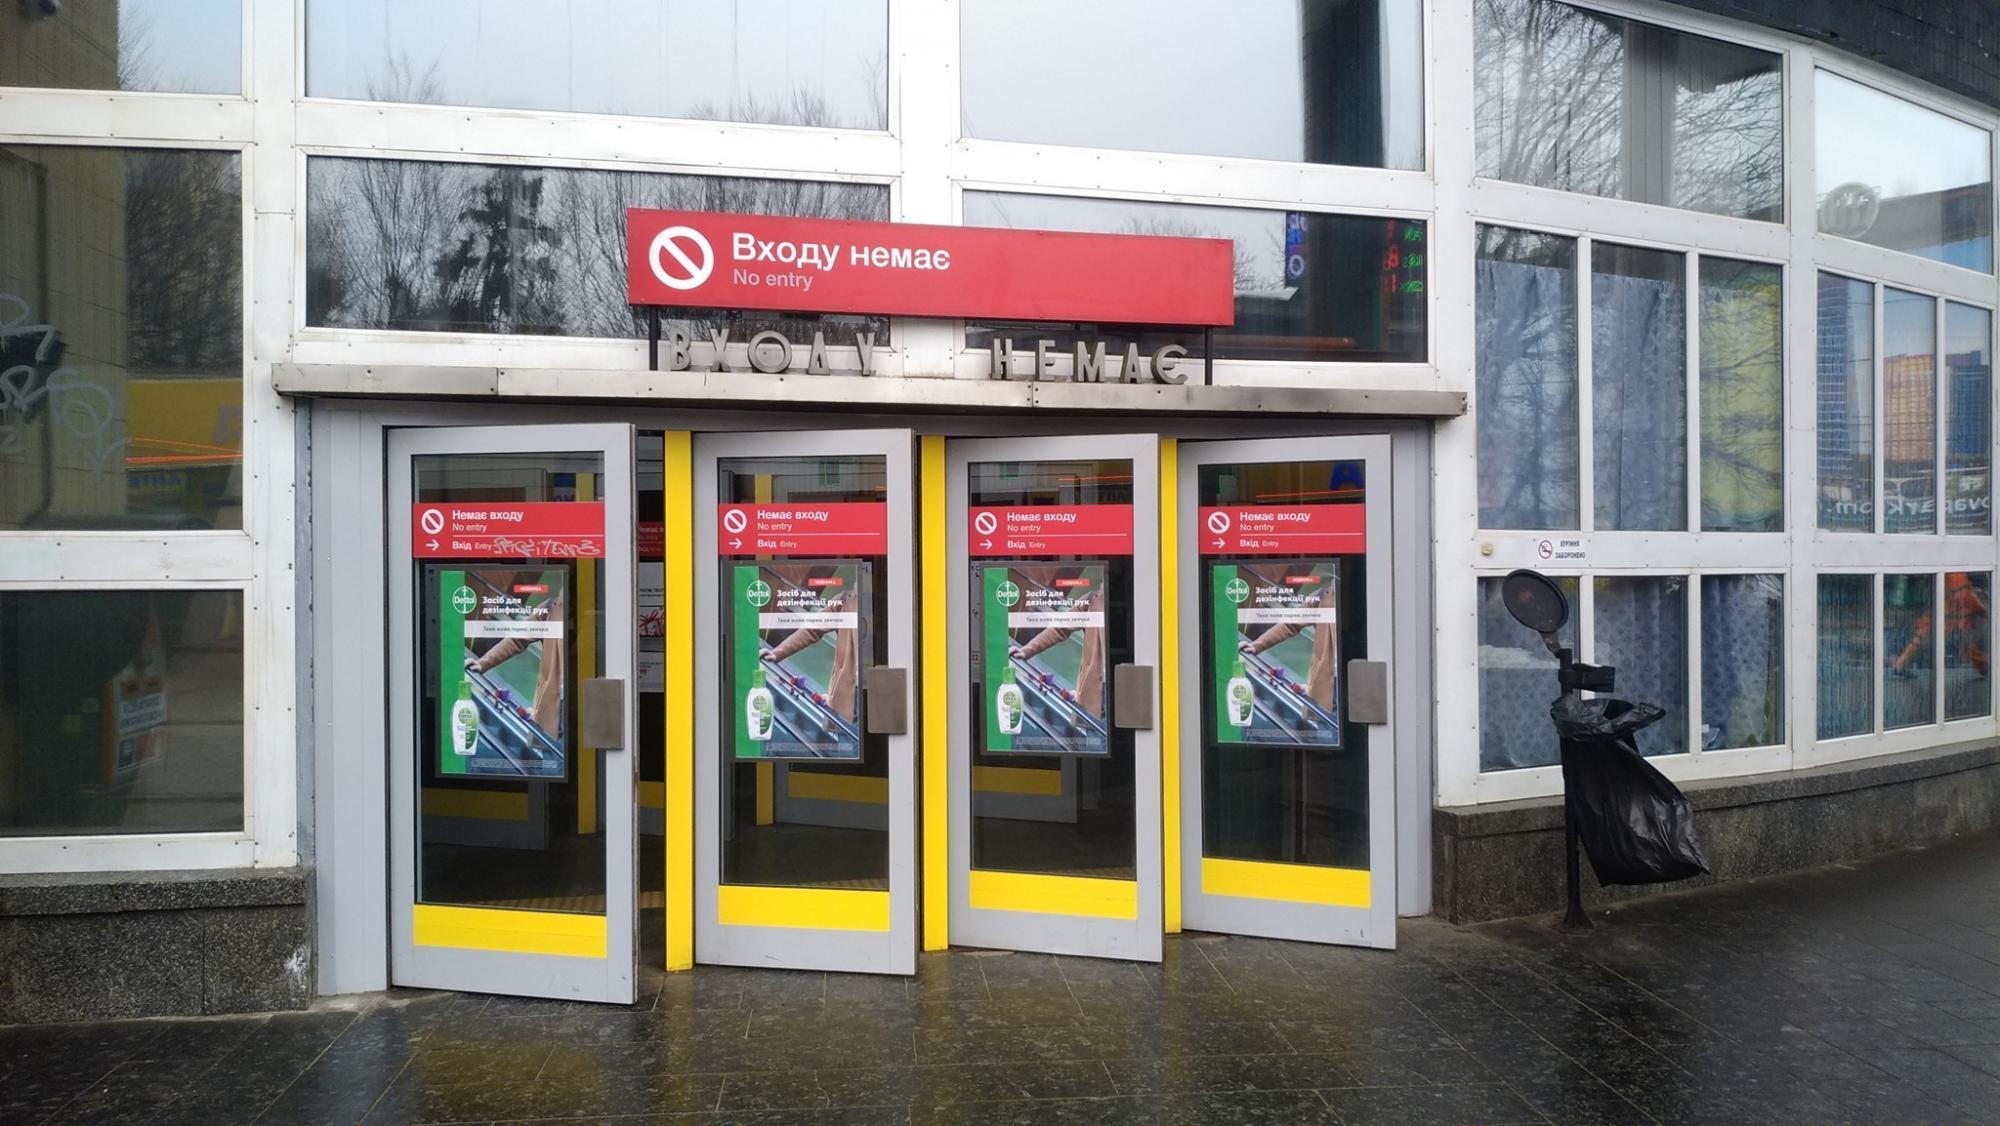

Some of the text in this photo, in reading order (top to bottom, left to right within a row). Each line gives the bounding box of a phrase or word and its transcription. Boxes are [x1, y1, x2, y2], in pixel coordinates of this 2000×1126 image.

[732, 232, 951, 271] Входу немає
[733, 269, 813, 292] No entry
[669, 328, 1188, 385] ВХОДУ НЕМАЄ
[452, 510, 524, 522] Немає входу
[757, 510, 829, 522] Немає входу
[1007, 512, 1076, 523] Немає входу
[1240, 511, 1311, 523] Немає входу
[452, 523, 487, 533] No entry
[757, 522, 793, 532] No entry
[1007, 524, 1041, 533] No entry
[1240, 523, 1274, 532] No entry
[452, 541, 472, 551] Вхід
[475, 542, 492, 551] Entry
[757, 540, 797, 549] Вхід Entry
[1007, 541, 1046, 550] Вхід Entry
[1240, 539, 1279, 548] Вхід Entry
[1555, 551, 1586, 559] ЗАБОРОНЕНО
[748, 590, 769, 598] Dettol
[777, 589, 799, 597] Засіб
[997, 590, 1018, 598] Dettol
[1227, 587, 1248, 595] Dettol
[1255, 586, 1277, 594] Засіб
[454, 596, 475, 604] Dettol
[482, 596, 522, 605] Засіб для
[777, 599, 826, 607] дезінфекції
[1025, 598, 1073, 607] дезінфекції
[1255, 595, 1320, 604] дезінфекції рук
[482, 605, 549, 615] дезінфекції рук
